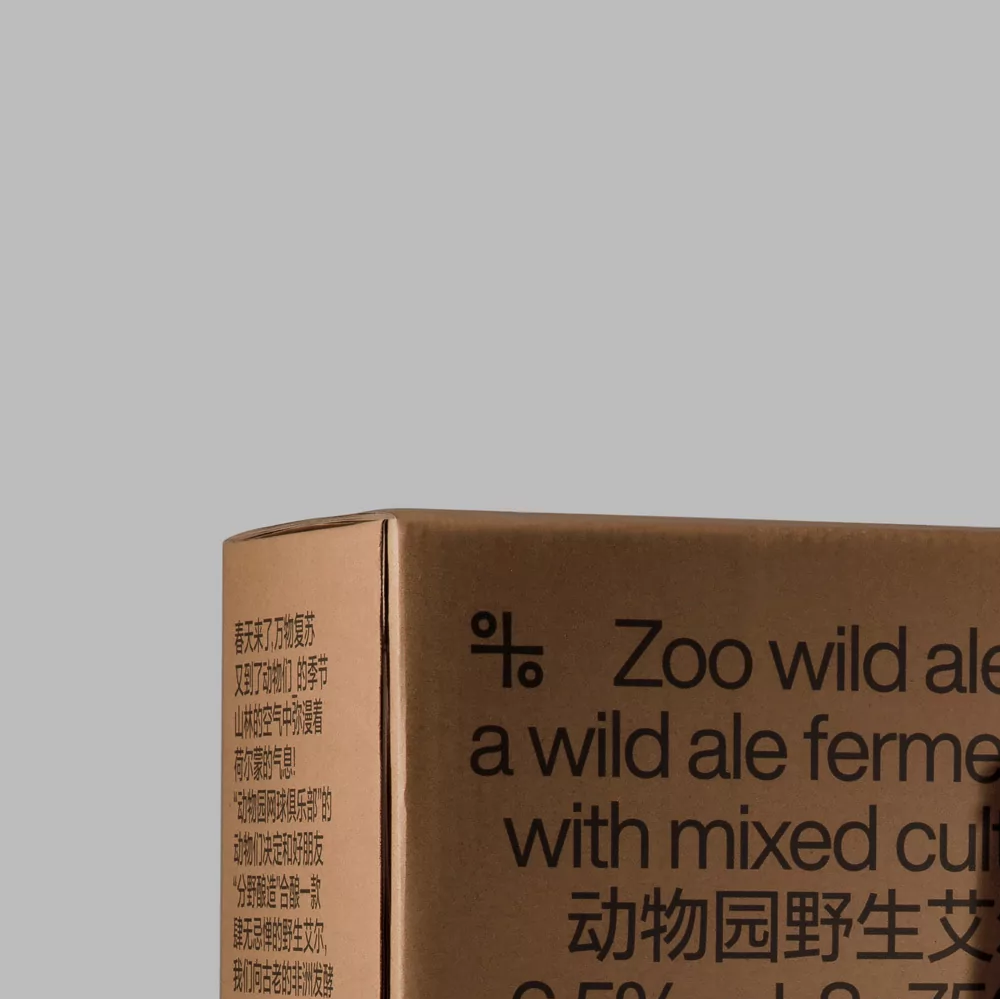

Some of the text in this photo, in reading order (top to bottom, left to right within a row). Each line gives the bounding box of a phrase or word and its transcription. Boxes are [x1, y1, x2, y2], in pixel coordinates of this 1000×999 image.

[613, 619, 753, 690] Zoo
[768, 625, 906, 693] wild
[470, 725, 514, 777] a
[527, 710, 669, 779] wild
[688, 712, 787, 781] ale
[234, 830, 323, 866] 动物们决定和好朋友
[503, 801, 649, 869] with
[671, 804, 877, 872] mixed
[233, 957, 333, 998] 我们向古老的非洲发酵
